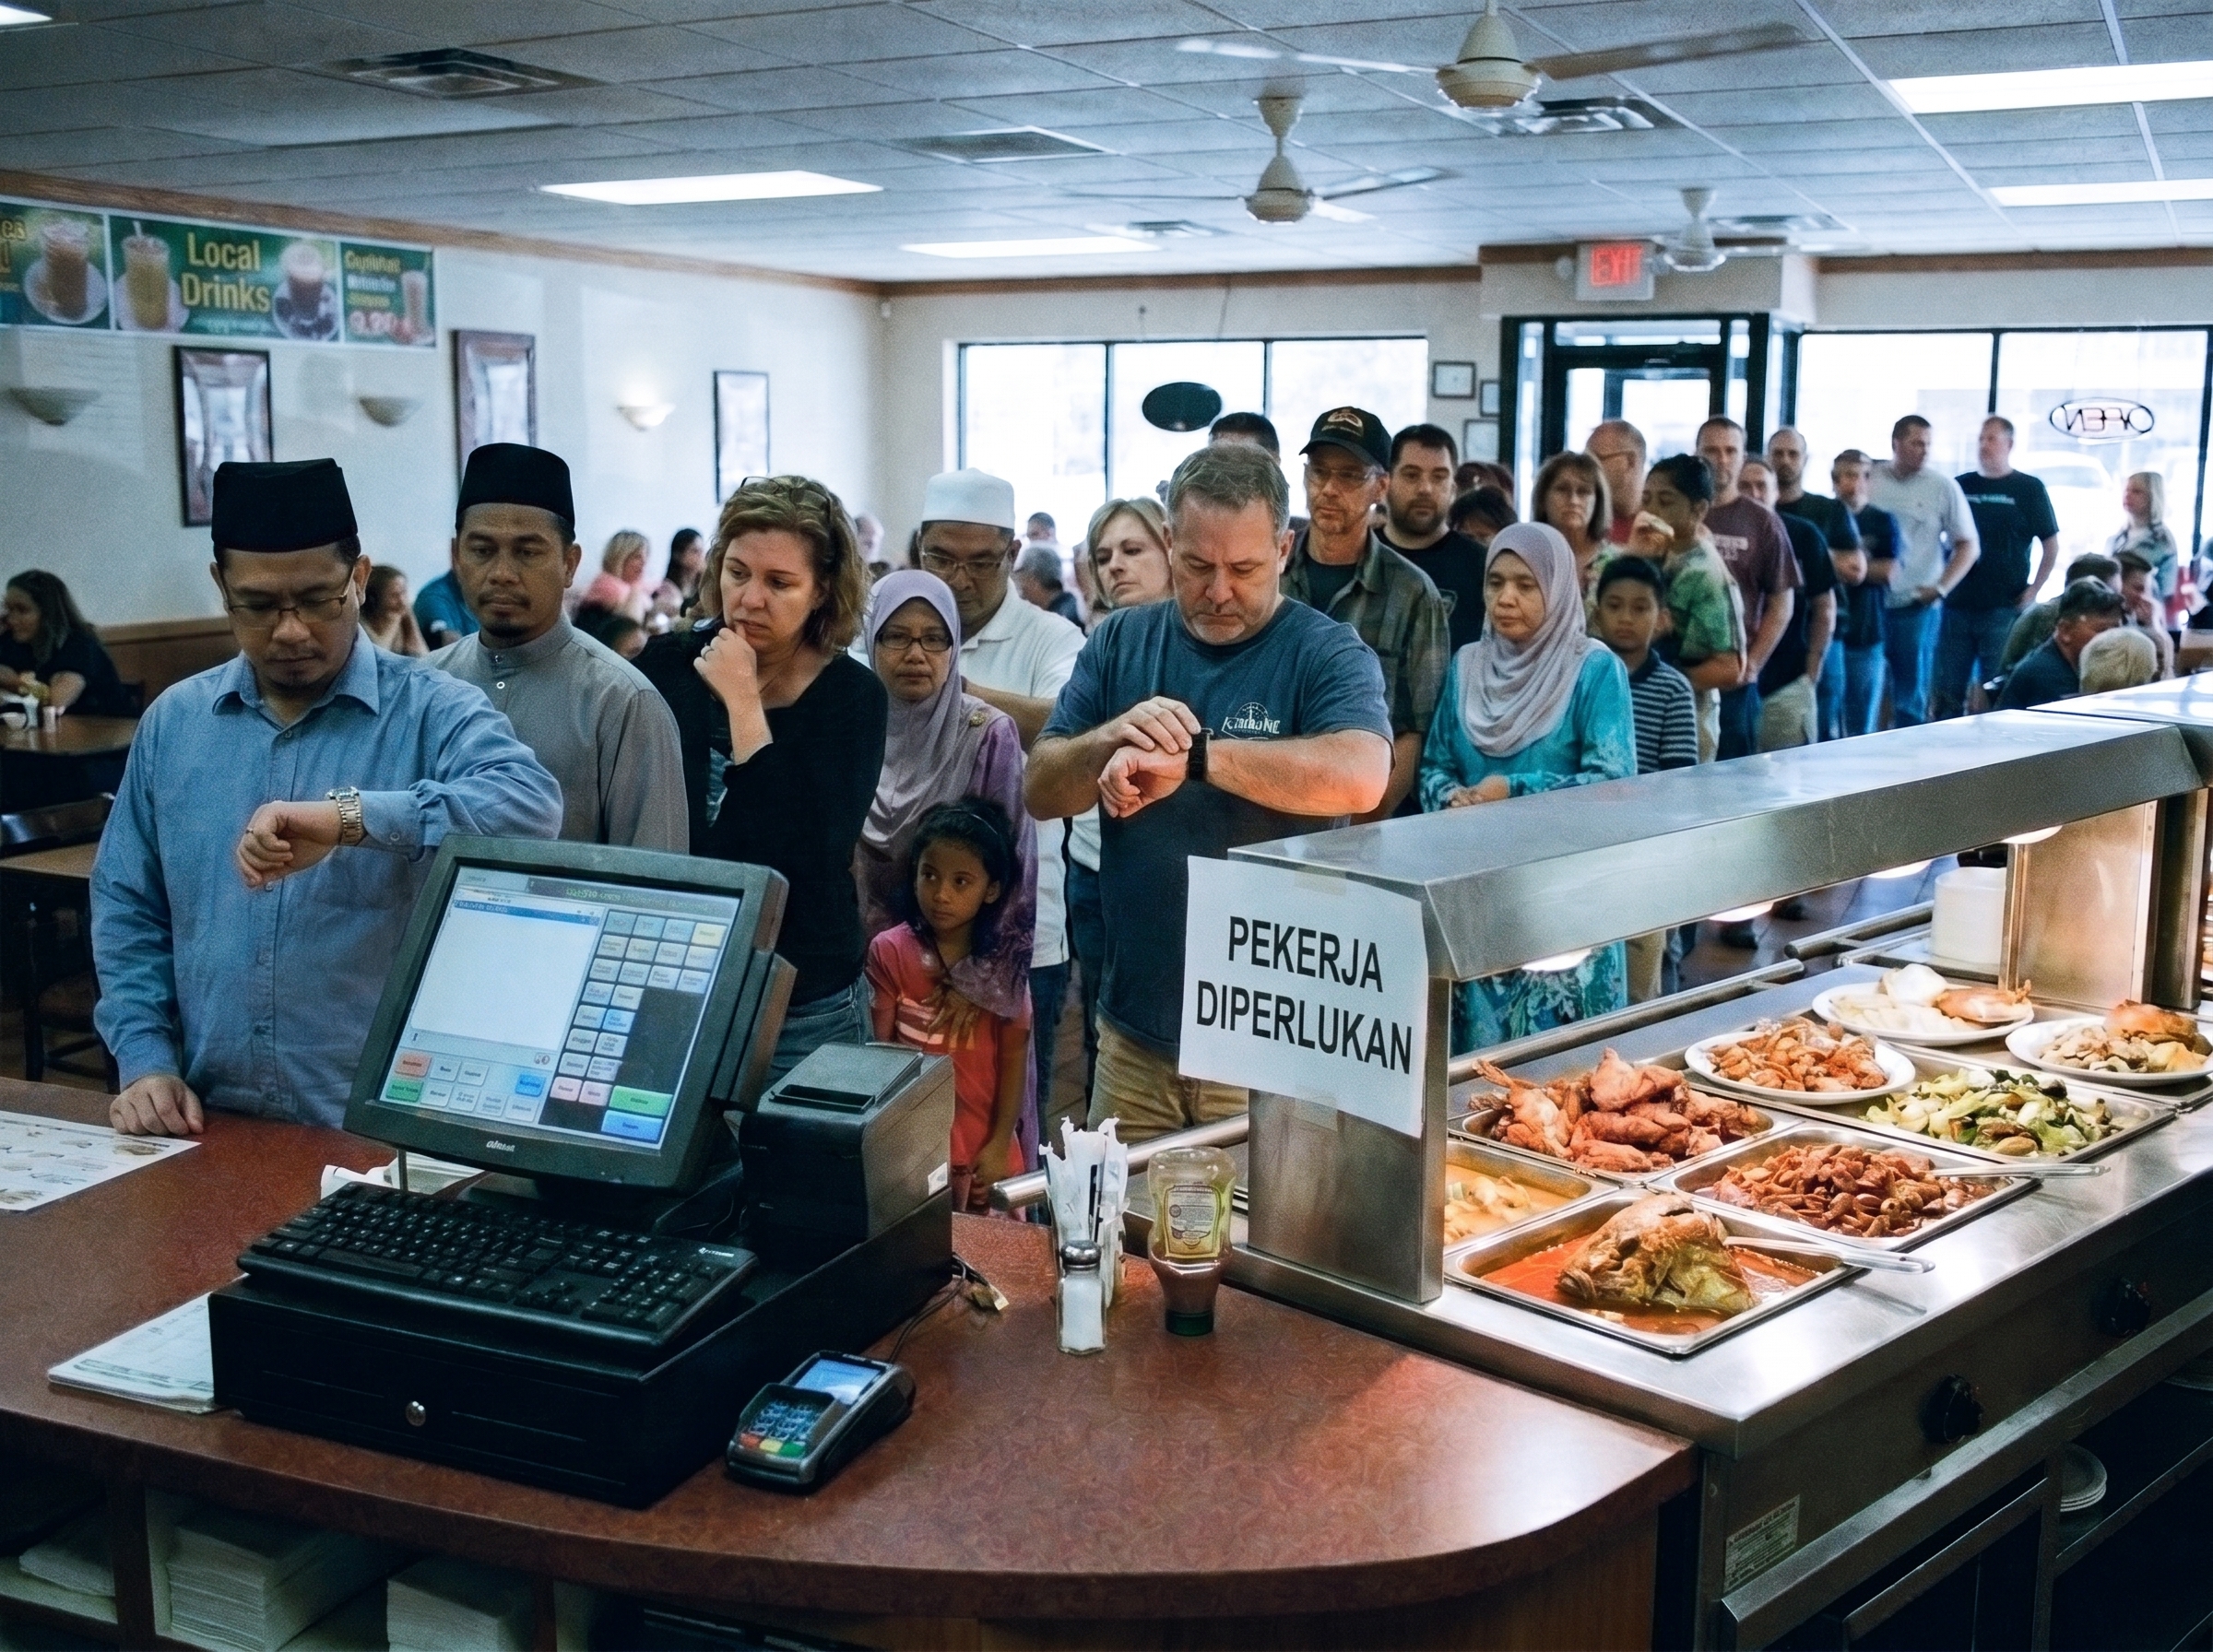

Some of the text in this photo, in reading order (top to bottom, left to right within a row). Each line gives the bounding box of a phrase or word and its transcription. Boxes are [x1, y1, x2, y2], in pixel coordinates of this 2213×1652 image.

[187, 232, 261, 271] Local
[182, 272, 271, 313] Drinks
[1228, 915, 1383, 993] PEKERJA
[1197, 980, 1413, 1075] DIPERLUKAN
